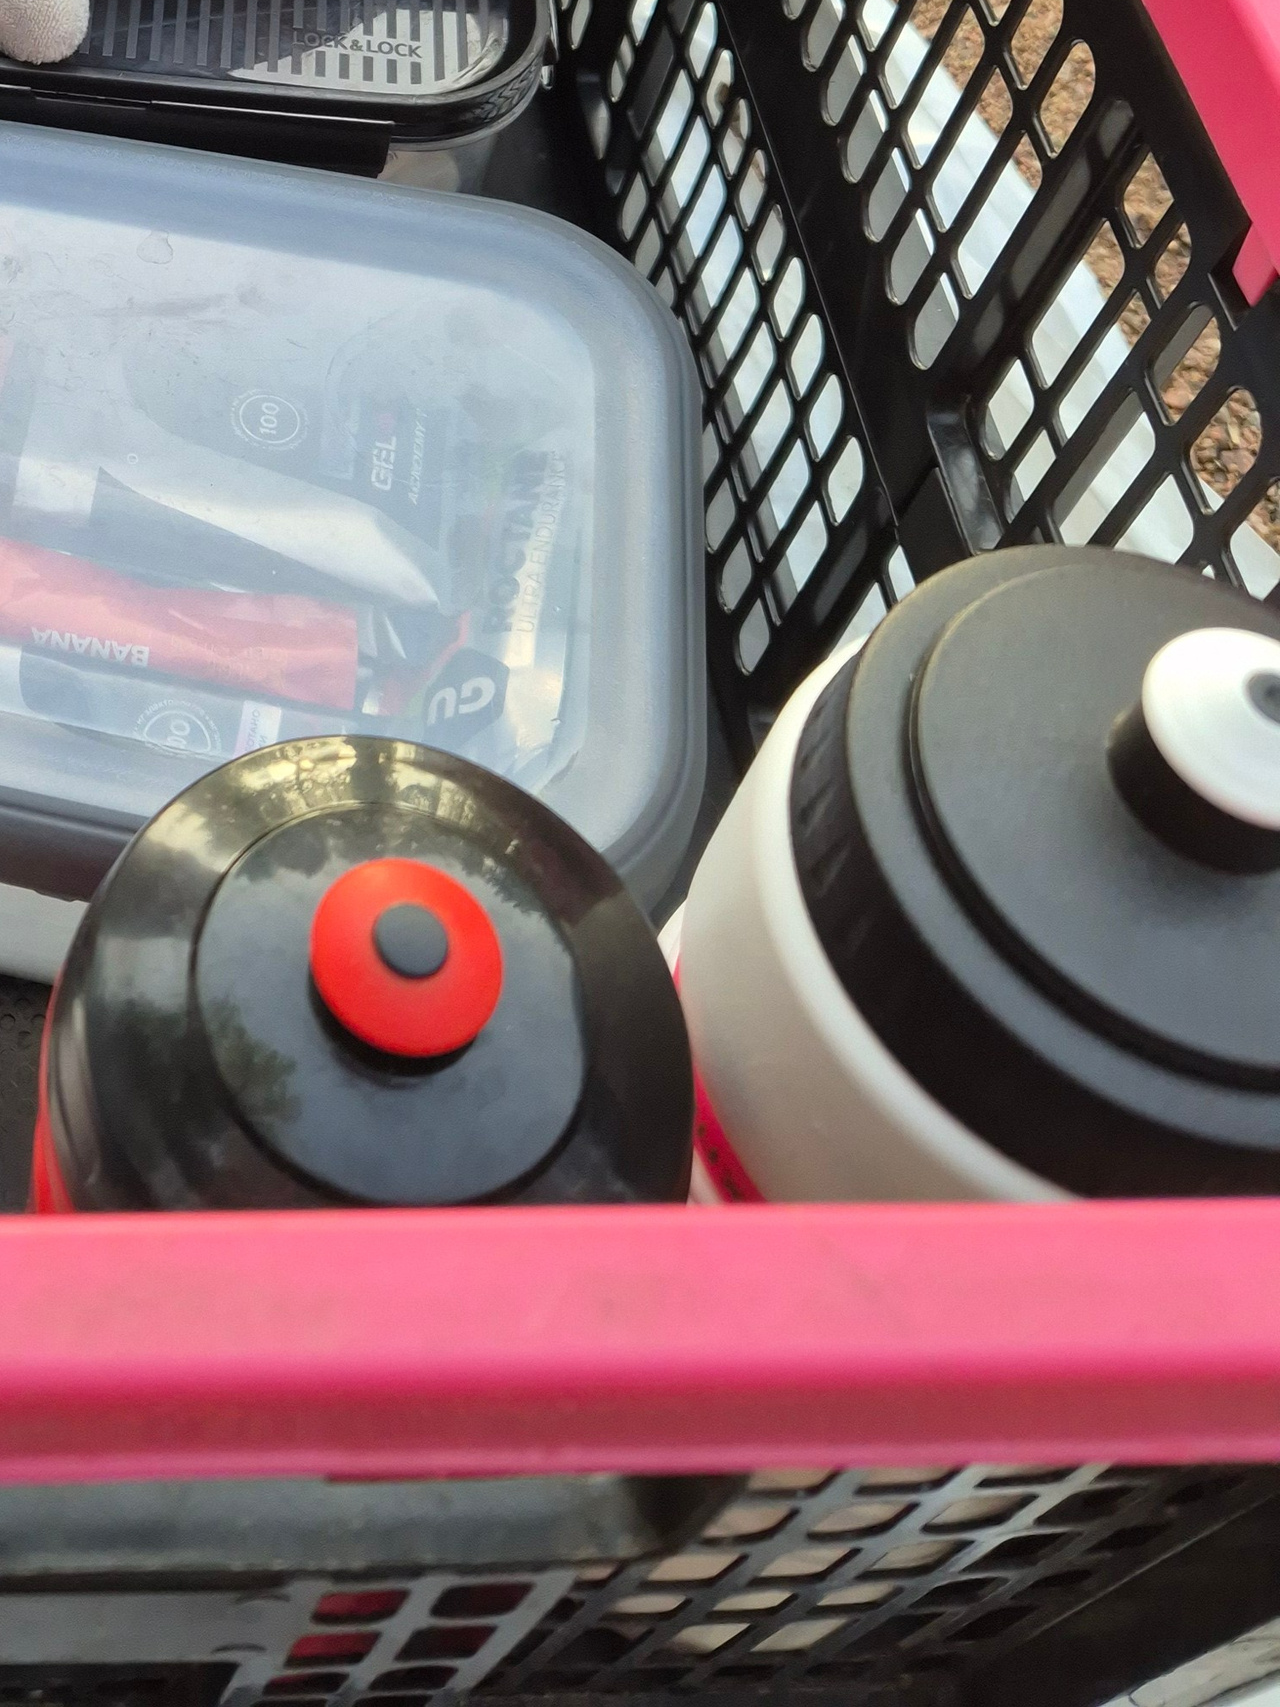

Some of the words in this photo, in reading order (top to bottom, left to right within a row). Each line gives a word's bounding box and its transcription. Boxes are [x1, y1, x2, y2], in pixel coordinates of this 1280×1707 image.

[293, 31, 423, 59] LOCK&LOCK
[259, 401, 281, 435] 100
[31, 626, 150, 669] BANANA
[427, 676, 496, 729] GU
